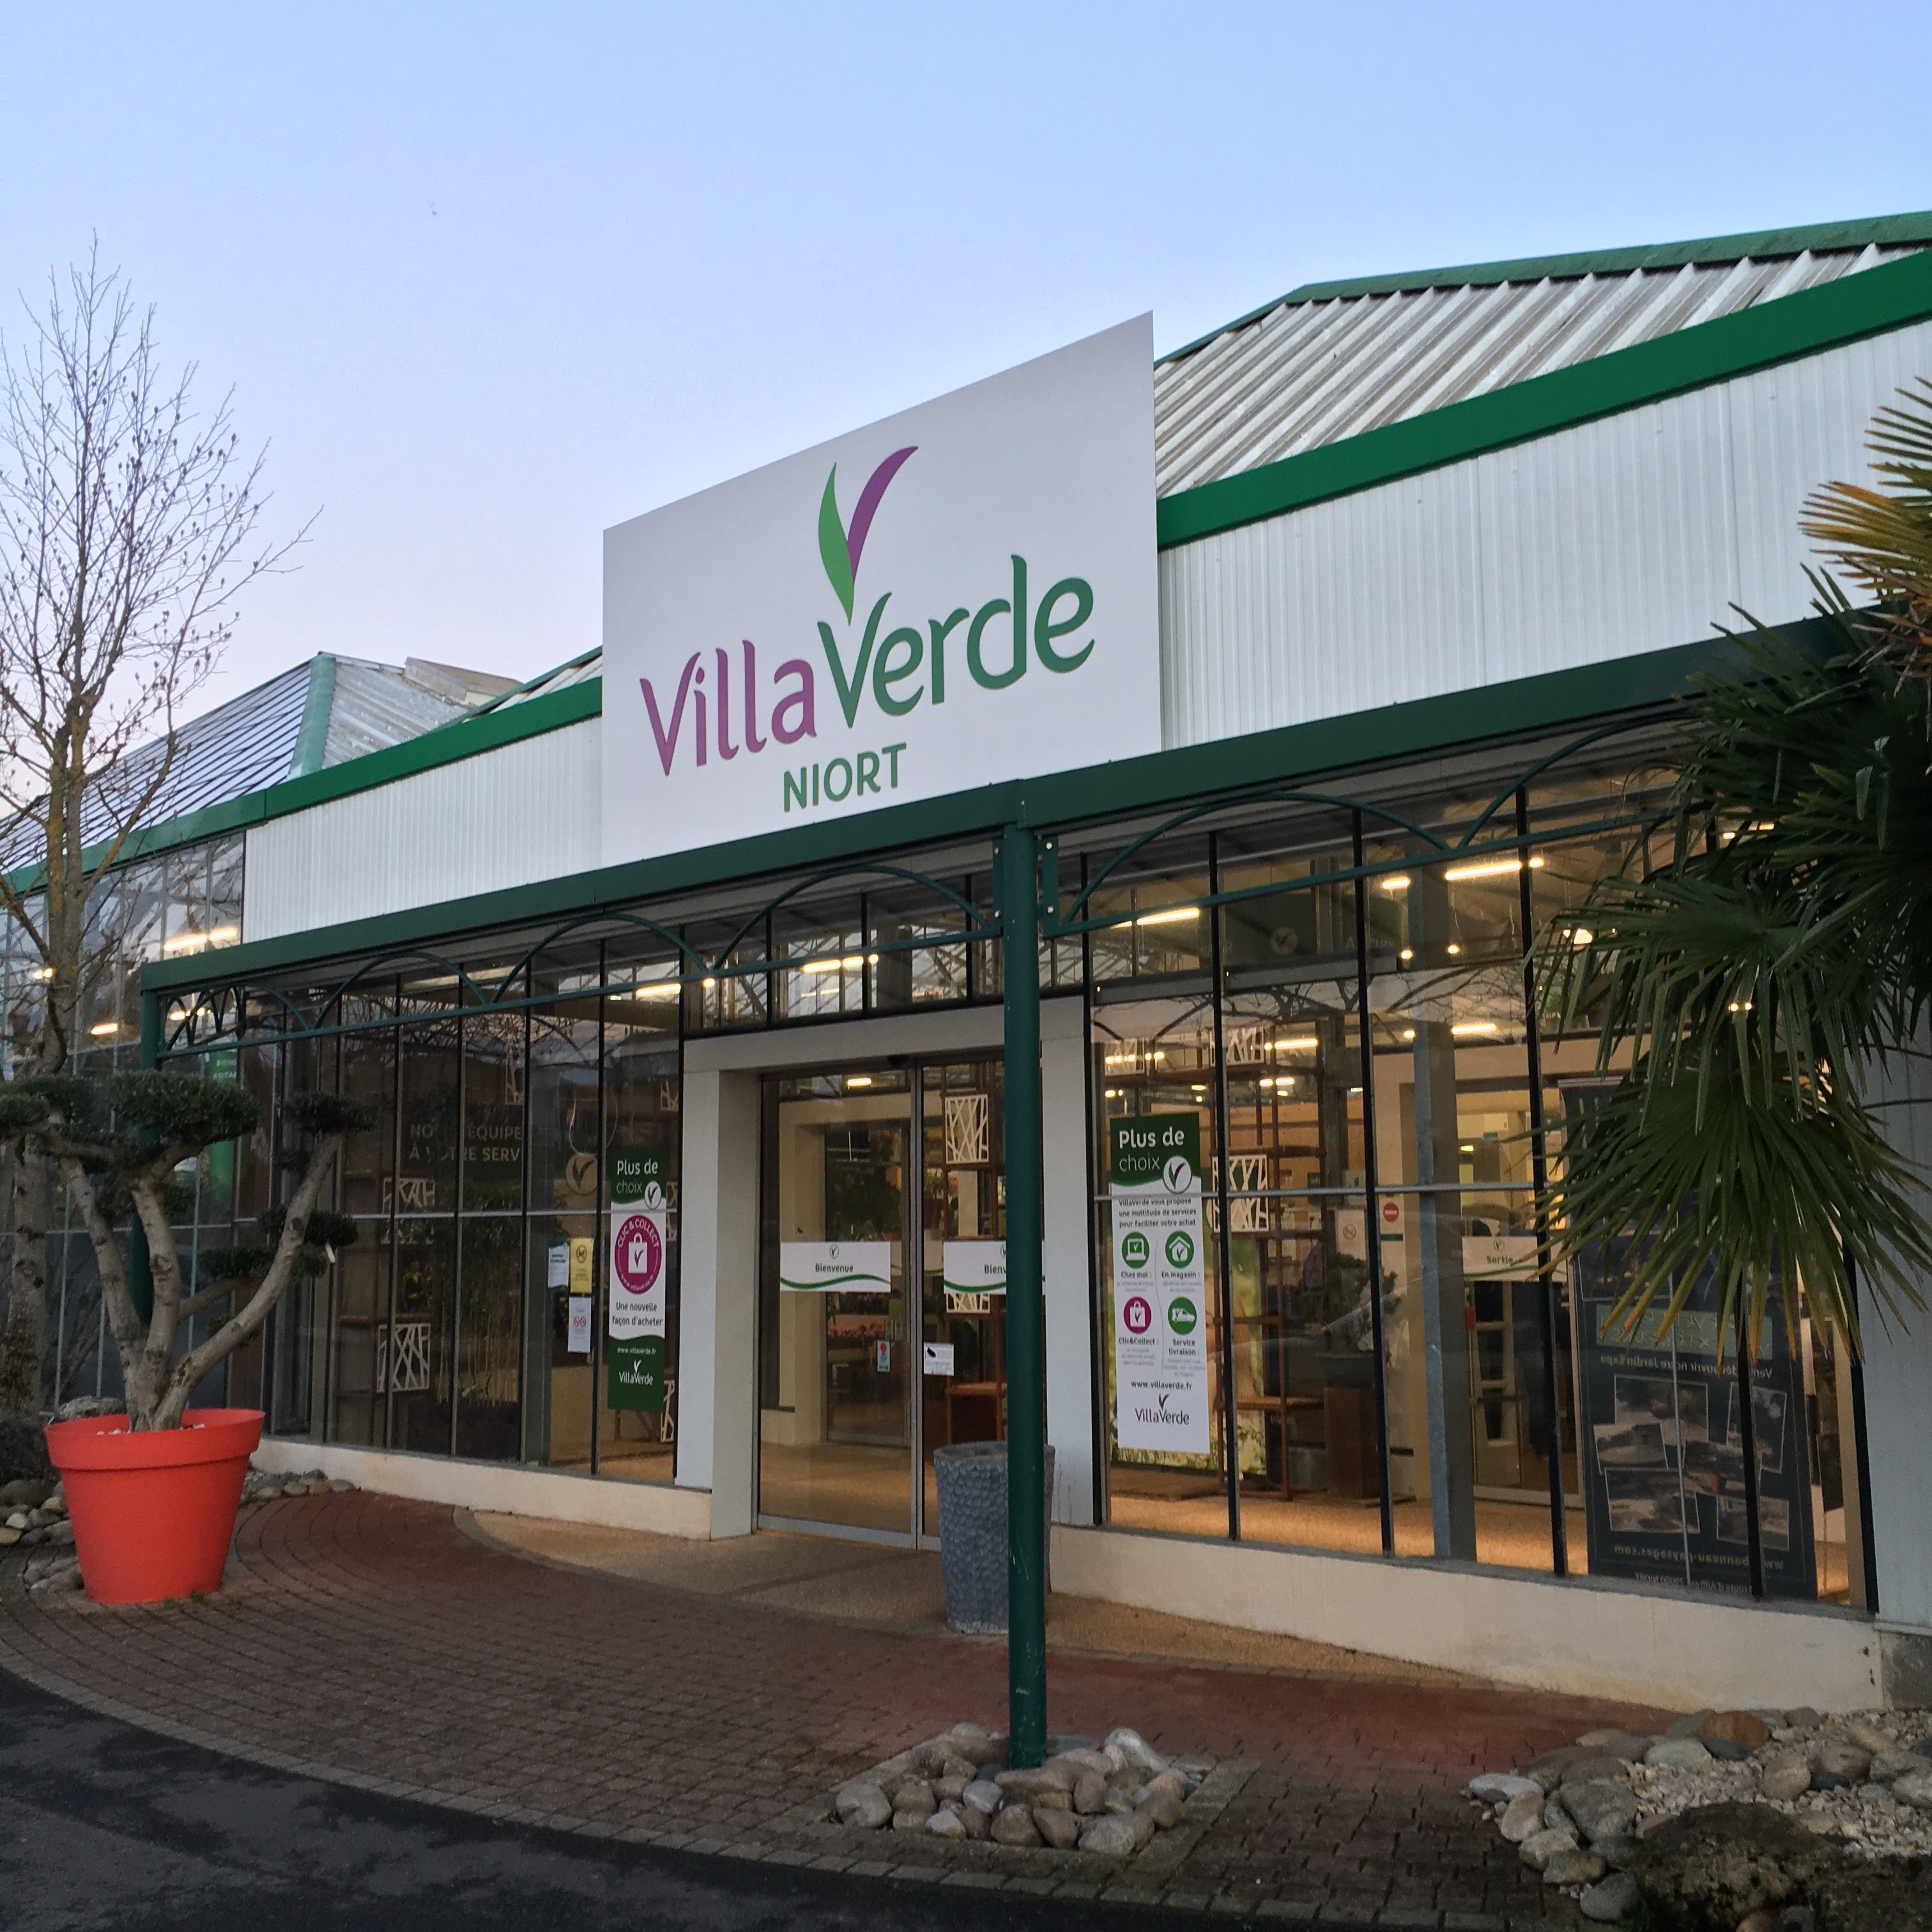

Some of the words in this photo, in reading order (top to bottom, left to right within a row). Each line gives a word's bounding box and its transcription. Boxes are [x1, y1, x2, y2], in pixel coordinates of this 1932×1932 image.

[640, 555, 1095, 777] VillaVerde
[783, 742, 907, 813] NIORT
[1119, 1128, 1156, 1149] Plus
[1163, 1126, 1184, 1147] de
[617, 1160, 640, 1176] Plus
[644, 1158, 658, 1174] de
[1119, 1153, 1160, 1172] choix
[617, 1179, 643, 1194] choix
[1166, 1198, 1192, 1206] propose
[1131, 1208, 1161, 1217] multitude
[1171, 1208, 1197, 1216] services
[618, 1225, 629, 1248] CLIC
[635, 1217, 659, 1248] COLLECT
[815, 1262, 854, 1273] Bienvenue
[984, 1264, 1006, 1275] Bienv
[1121, 1270, 1135, 1278] Chez
[1170, 1270, 1197, 1280] magasin
[616, 1301, 628, 1312] Une
[630, 1301, 657, 1312] nouvelle
[612, 1315, 630, 1326] façon
[632, 1315, 663, 1326] d'acheter
[1169, 1347, 1196, 1355] livraison
[618, 1371, 654, 1386] VillaVerde
[1131, 1380, 1192, 1390] www.villaverde.fr
[1135, 1407, 1190, 1425] VillaVerde
